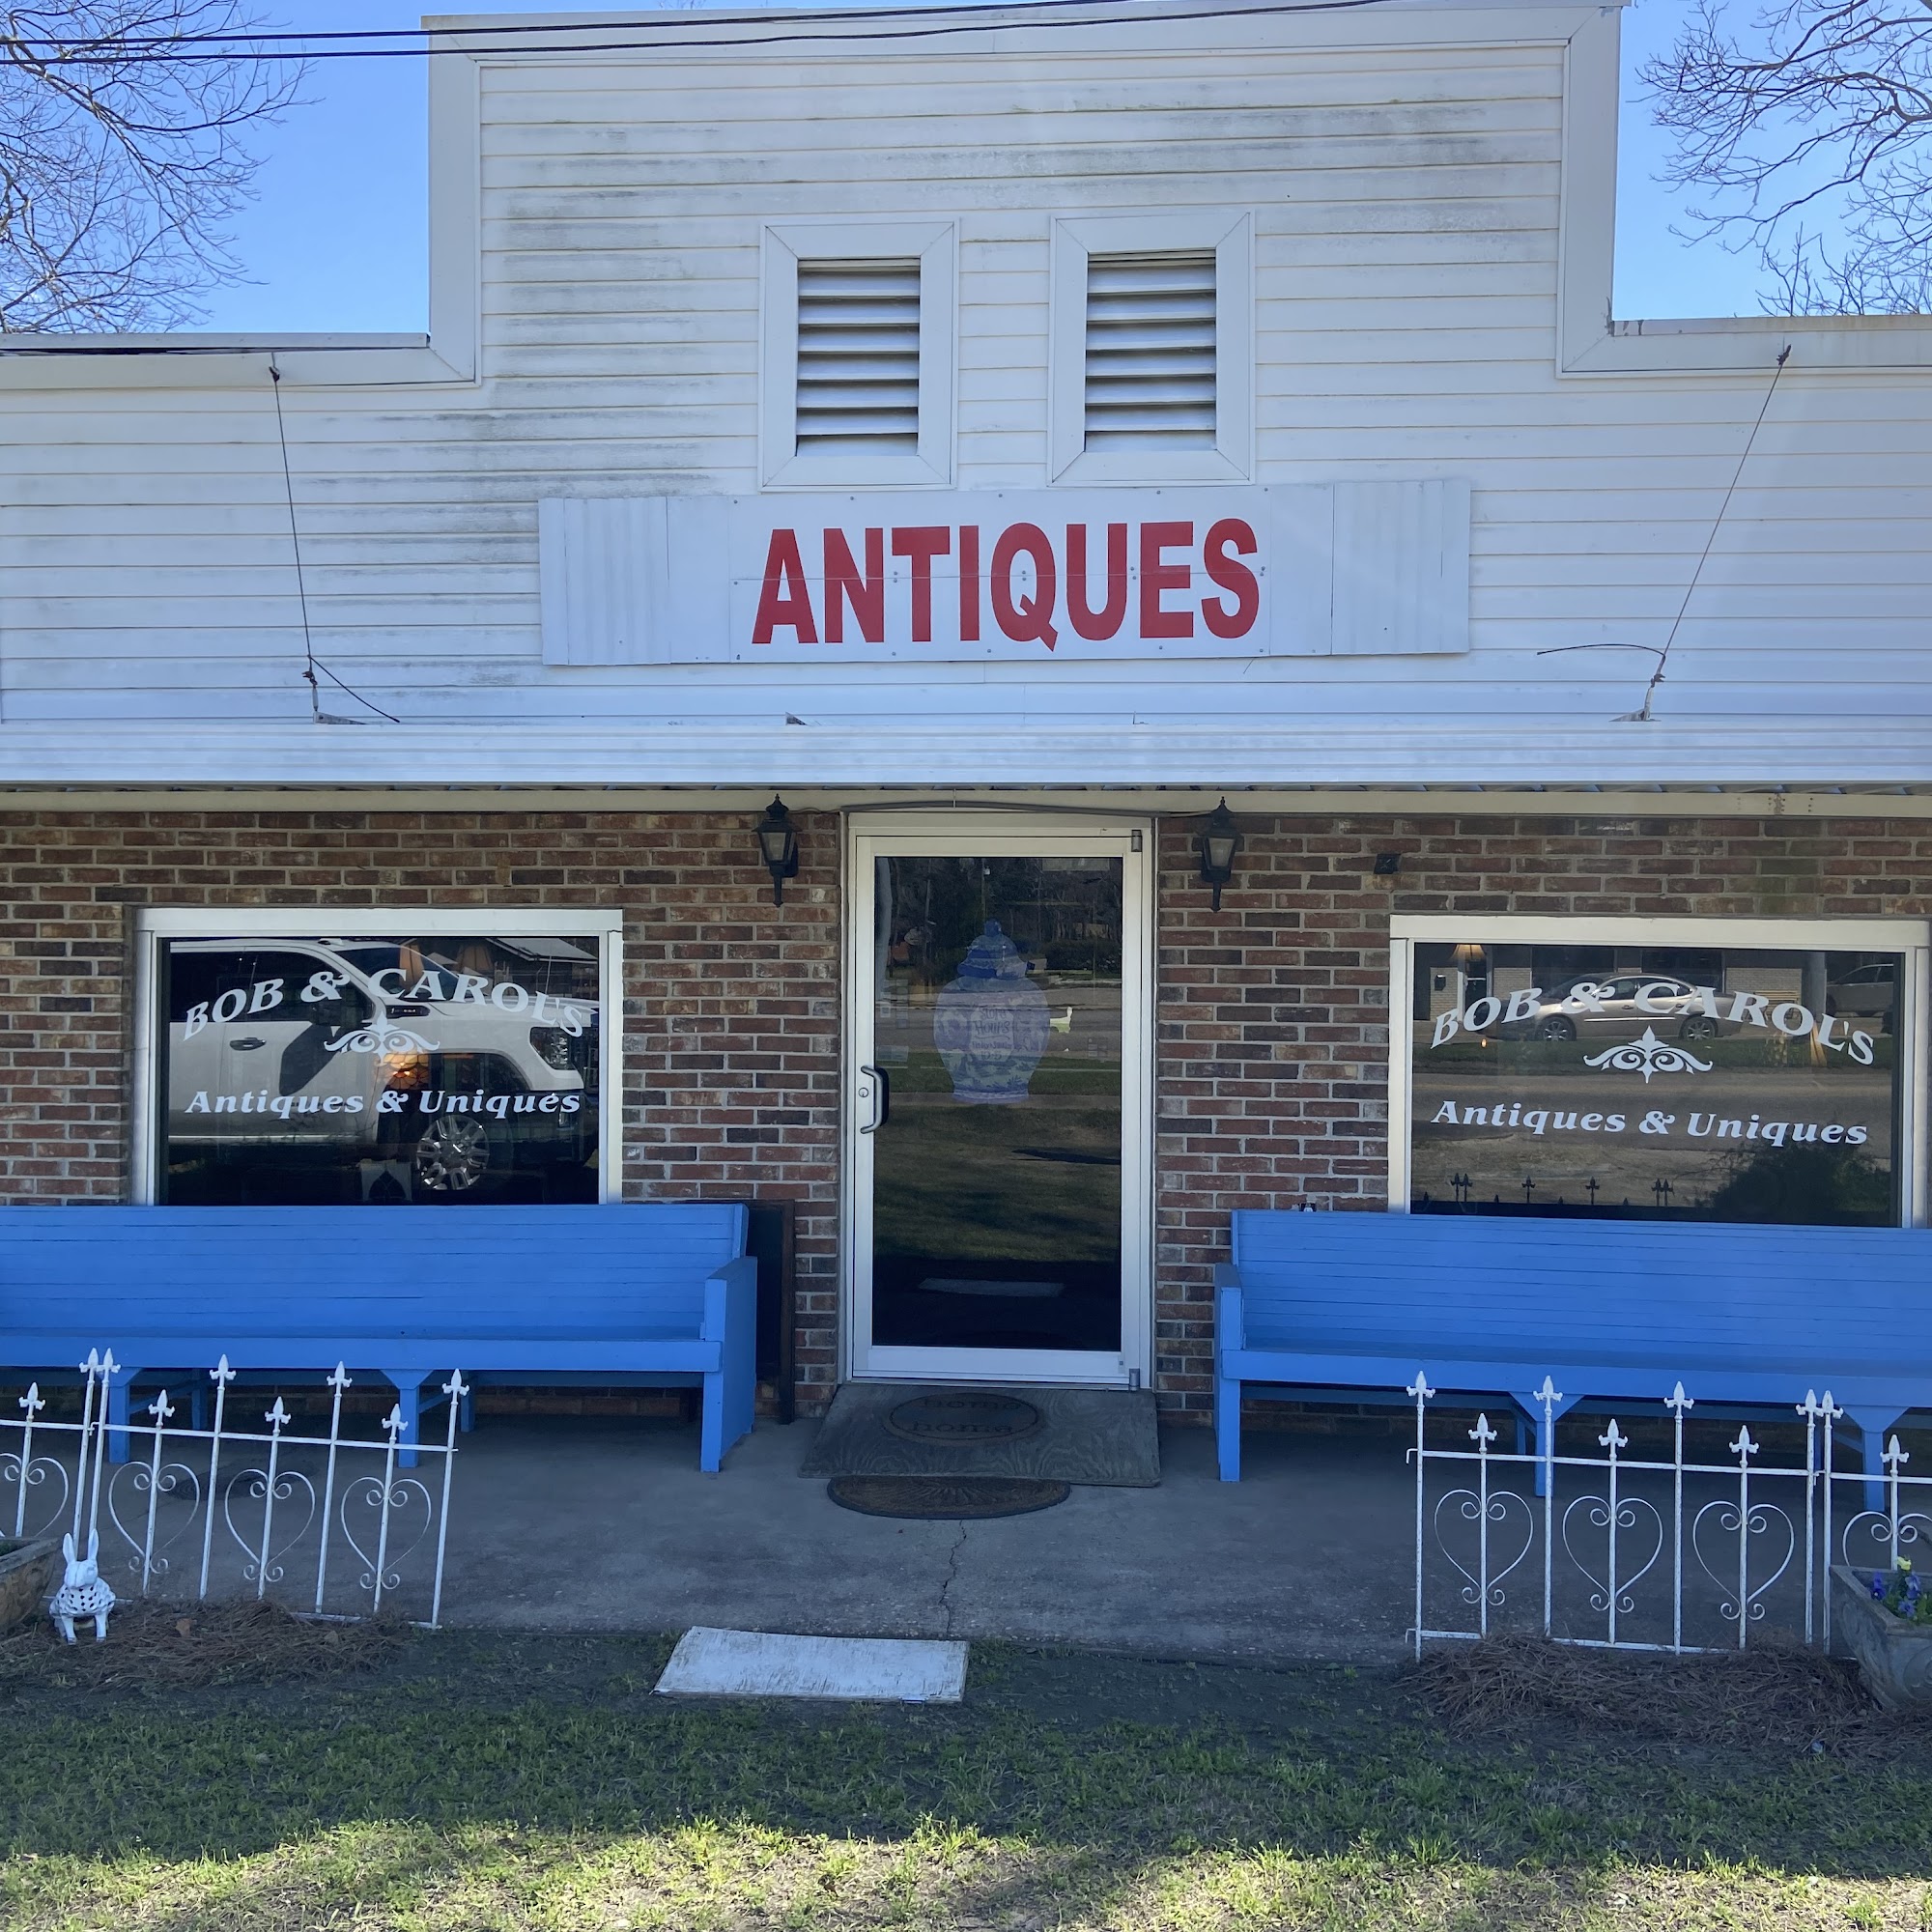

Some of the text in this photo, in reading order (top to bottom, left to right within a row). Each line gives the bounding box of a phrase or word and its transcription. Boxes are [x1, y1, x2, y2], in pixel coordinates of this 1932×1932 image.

[751, 518, 1260, 652] ANTIQUES
[183, 968, 584, 1041] BOB & CAROL'S
[1430, 981, 1875, 1065] BOB & CAROL'S
[185, 1089, 582, 1119] Antiques & Uniques
[1430, 1099, 1868, 1149] Antiques & Uniques
